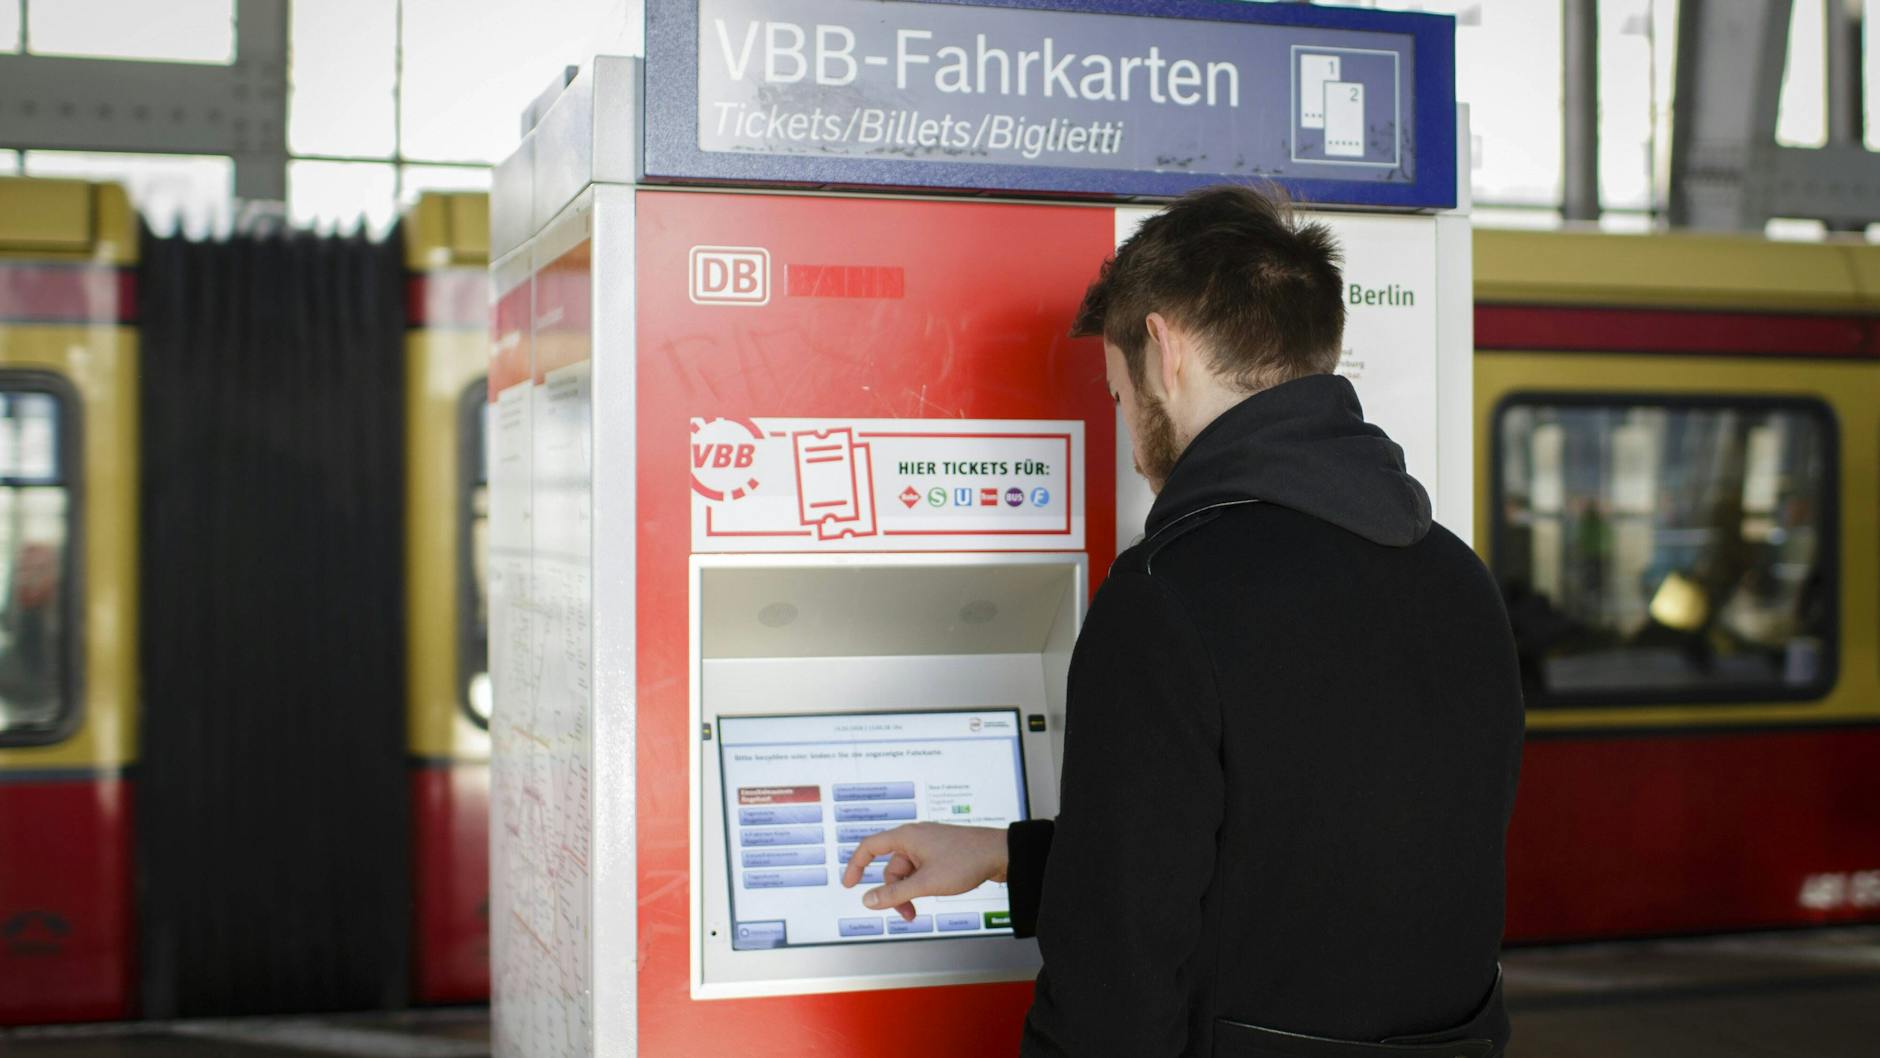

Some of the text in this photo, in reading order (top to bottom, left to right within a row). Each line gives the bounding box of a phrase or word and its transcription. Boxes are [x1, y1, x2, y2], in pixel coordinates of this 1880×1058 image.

[714, 19, 1239, 107] VBB-Fahrkarten
[1328, 60, 1335, 75] 1
[1349, 86, 1360, 102] 2
[713, 101, 1124, 159] Tickets/Billets/Biglietti
[700, 255, 760, 296] DB
[1349, 283, 1415, 306] Berlin
[692, 443, 755, 469] VBB
[898, 458, 1050, 475] HIER TICKETS FÜR:
[929, 488, 946, 507] S
[955, 488, 971, 506] U
[1005, 493, 1024, 502] BUS
